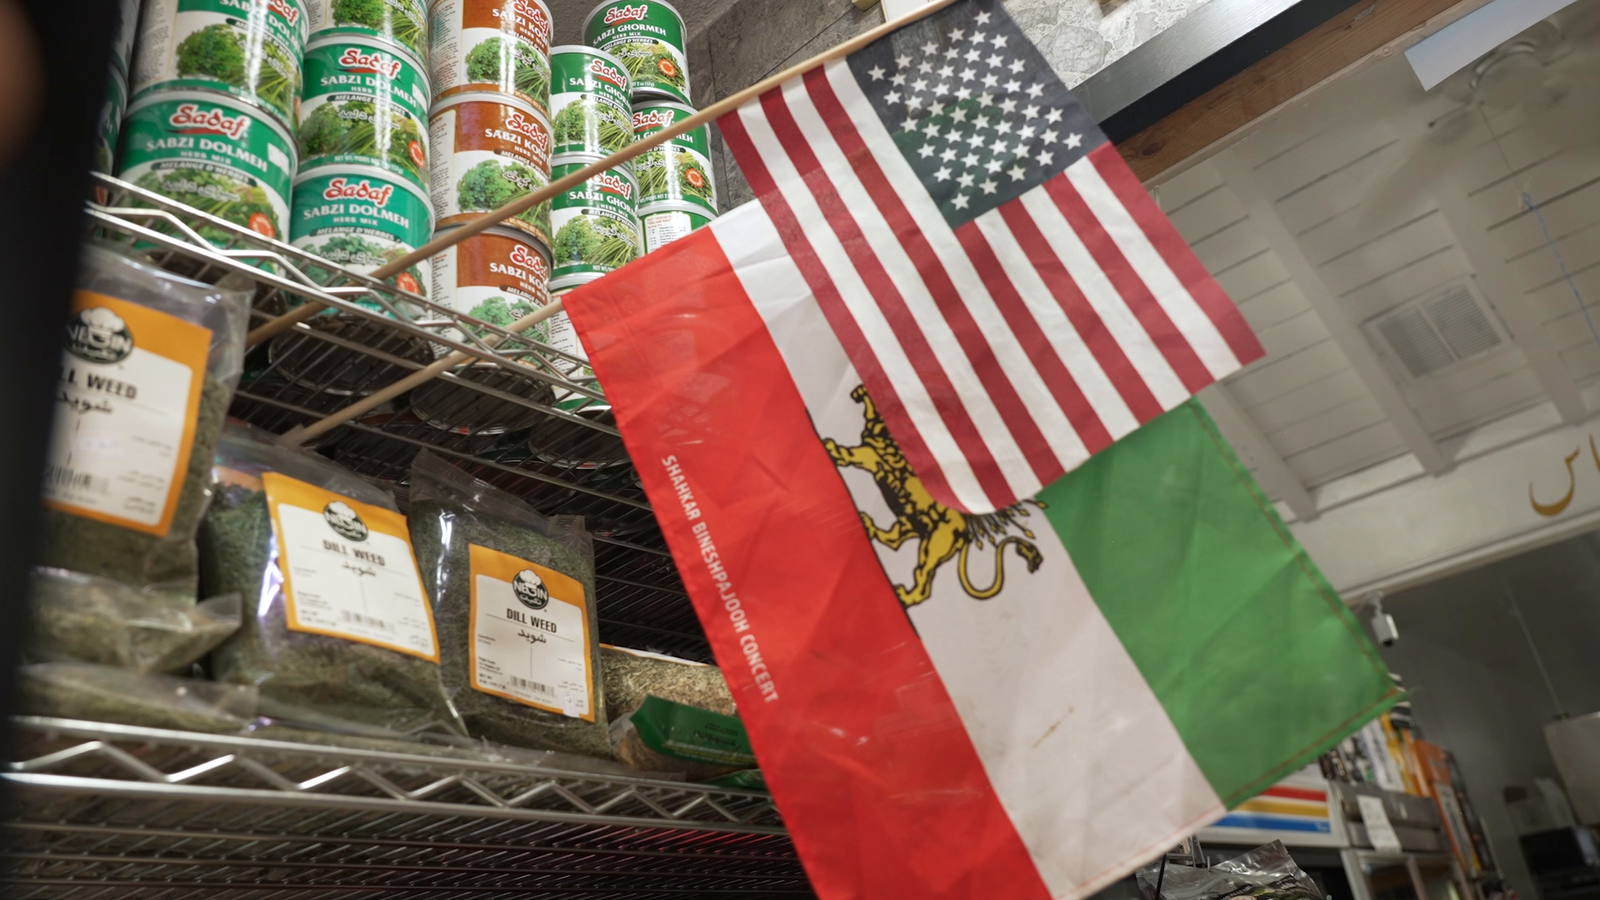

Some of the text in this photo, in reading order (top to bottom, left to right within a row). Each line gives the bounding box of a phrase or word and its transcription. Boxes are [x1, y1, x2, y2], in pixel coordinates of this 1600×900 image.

[604, 4, 648, 24] Sadaf
[592, 24, 667, 47] SABZI GHORMEH
[338, 48, 402, 79] Sadaf
[590, 59, 627, 91] Sadaf
[320, 75, 416, 108] SABZI DOLMEH
[569, 78, 602, 89] SAZI
[169, 104, 251, 140] Sadaf
[633, 110, 674, 127] Sadaf
[485, 128, 522, 144] SABZI
[505, 112, 548, 151] Sadaf
[146, 137, 268, 172] SABZI DOLMEH
[323, 177, 393, 208] Sadaf
[569, 191, 603, 201] SABZI
[303, 204, 409, 229] SABZI DOLMEH
[489, 262, 526, 280] SABZI
[87, 372, 137, 399] WEED
[353, 547, 386, 567] WEED
[514, 580, 547, 601] NEGIN
[661, 455, 779, 703] SHAHKAR BINESHPAJOOH CONCERT
[507, 608, 557, 633] DILL WEED
[517, 629, 546, 644] شوید
